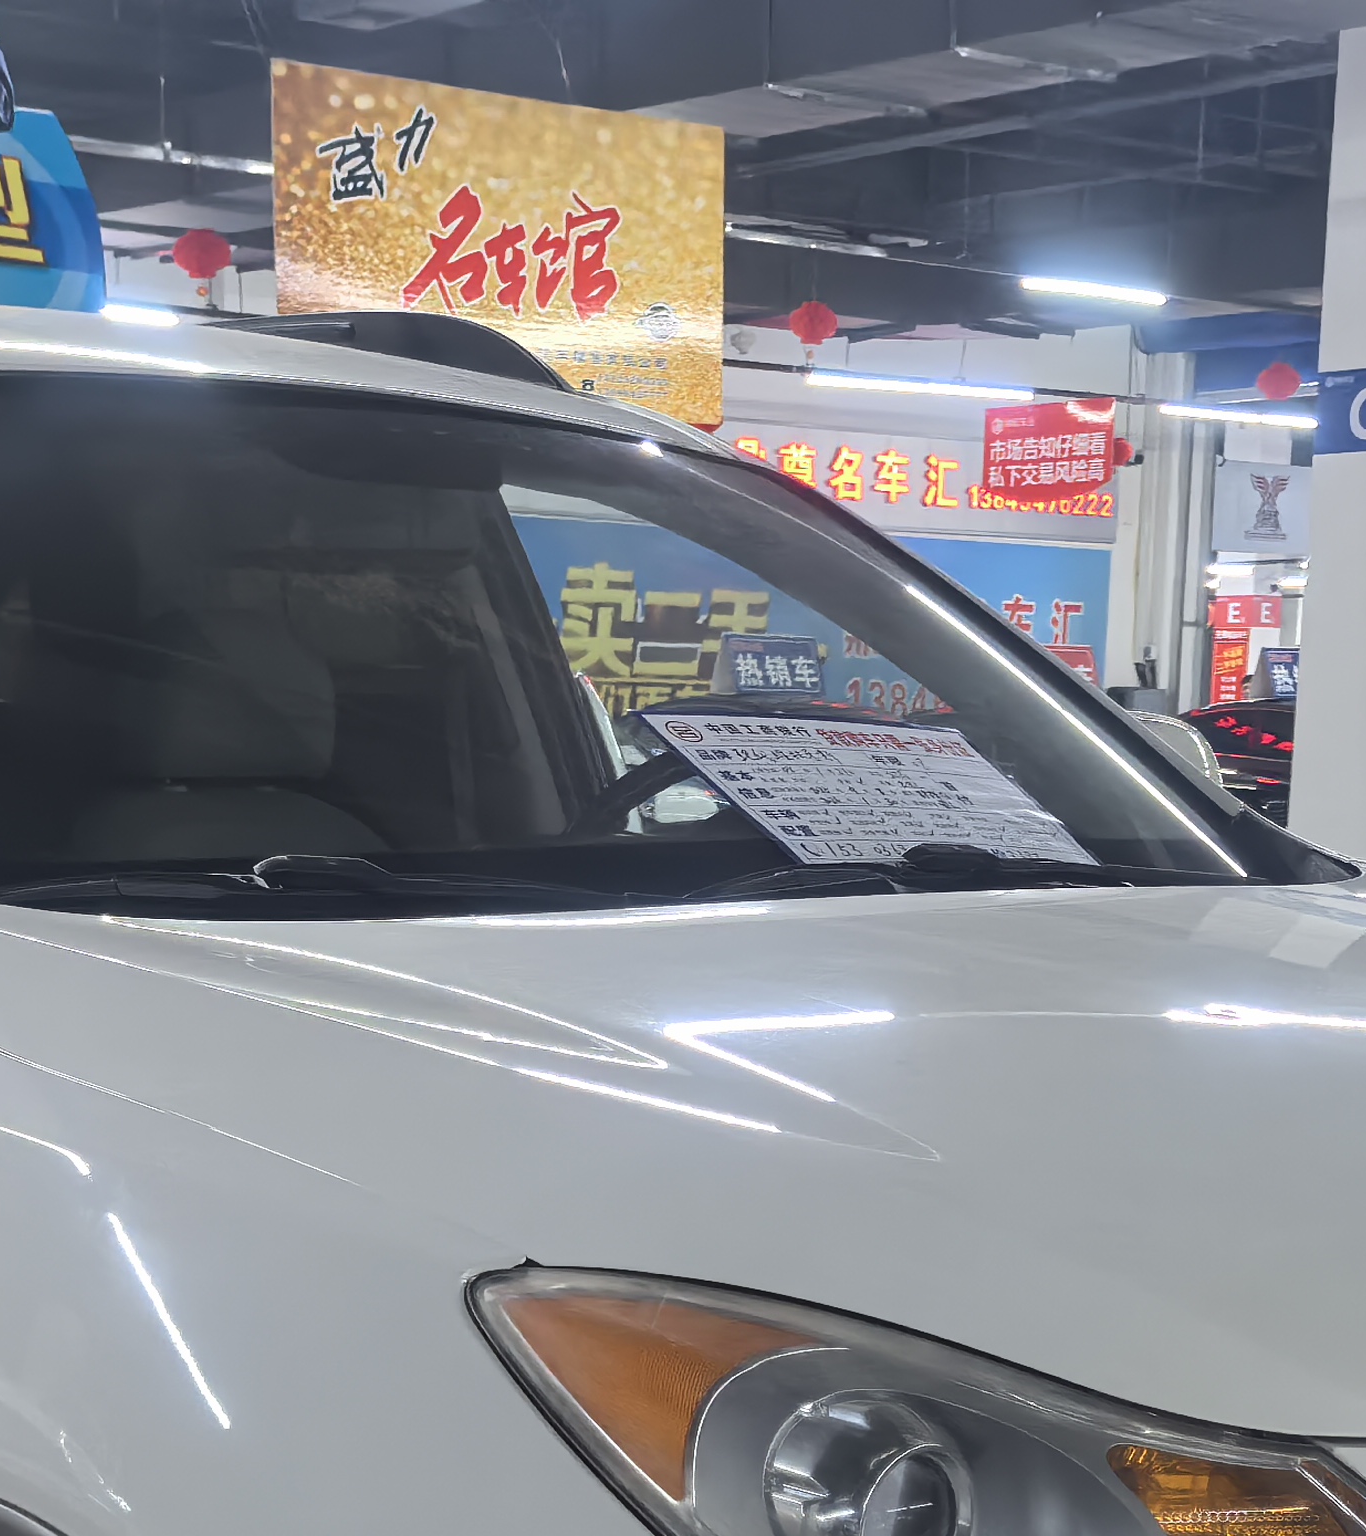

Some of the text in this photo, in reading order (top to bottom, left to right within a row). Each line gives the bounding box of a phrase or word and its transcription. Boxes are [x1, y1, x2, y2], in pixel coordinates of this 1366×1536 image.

[402, 186, 620, 321] 名车馆
[988, 432, 1107, 462] 市场告知仔细看
[988, 459, 1106, 488] 私下交易风险高
